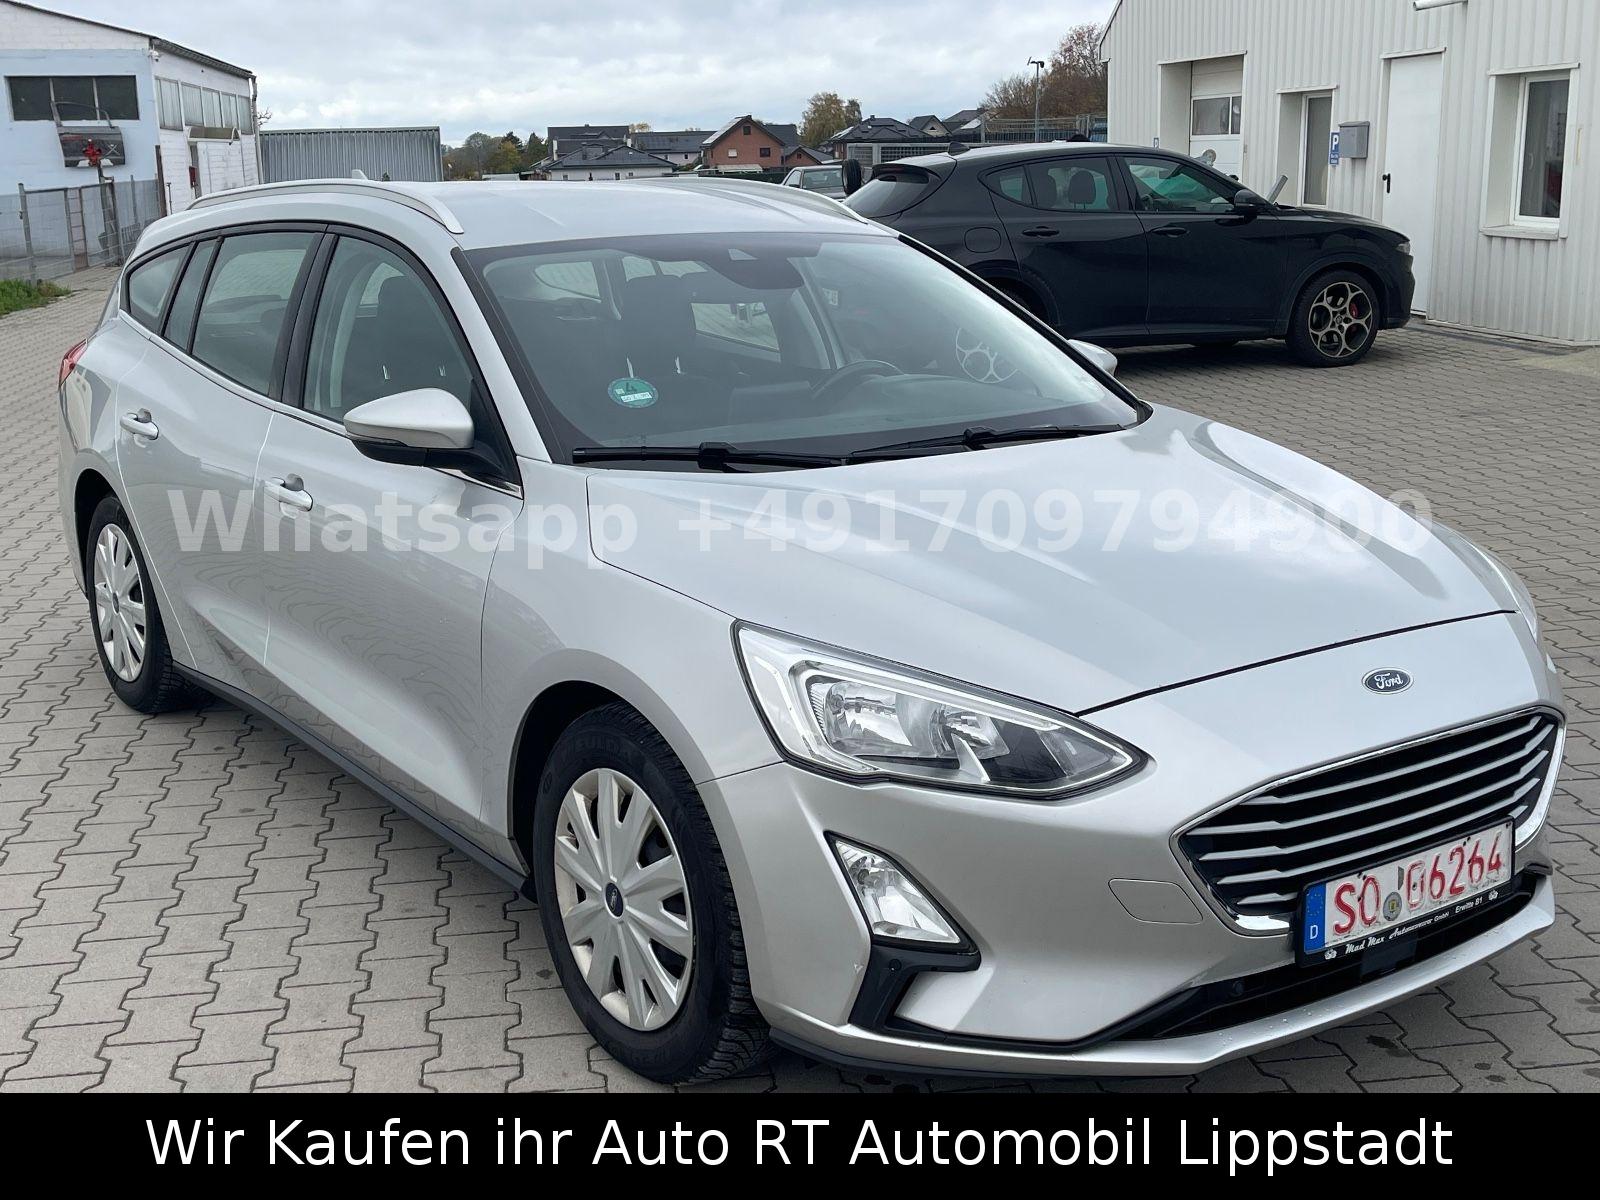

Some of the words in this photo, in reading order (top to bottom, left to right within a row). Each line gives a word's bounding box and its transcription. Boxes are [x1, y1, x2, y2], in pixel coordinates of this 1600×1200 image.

[1332, 134, 1339, 150] P
[1374, 672, 1403, 689] Ford
[1310, 925, 1319, 940] D
[1345, 939, 1365, 954] Mad
[1367, 936, 1386, 947] Max
